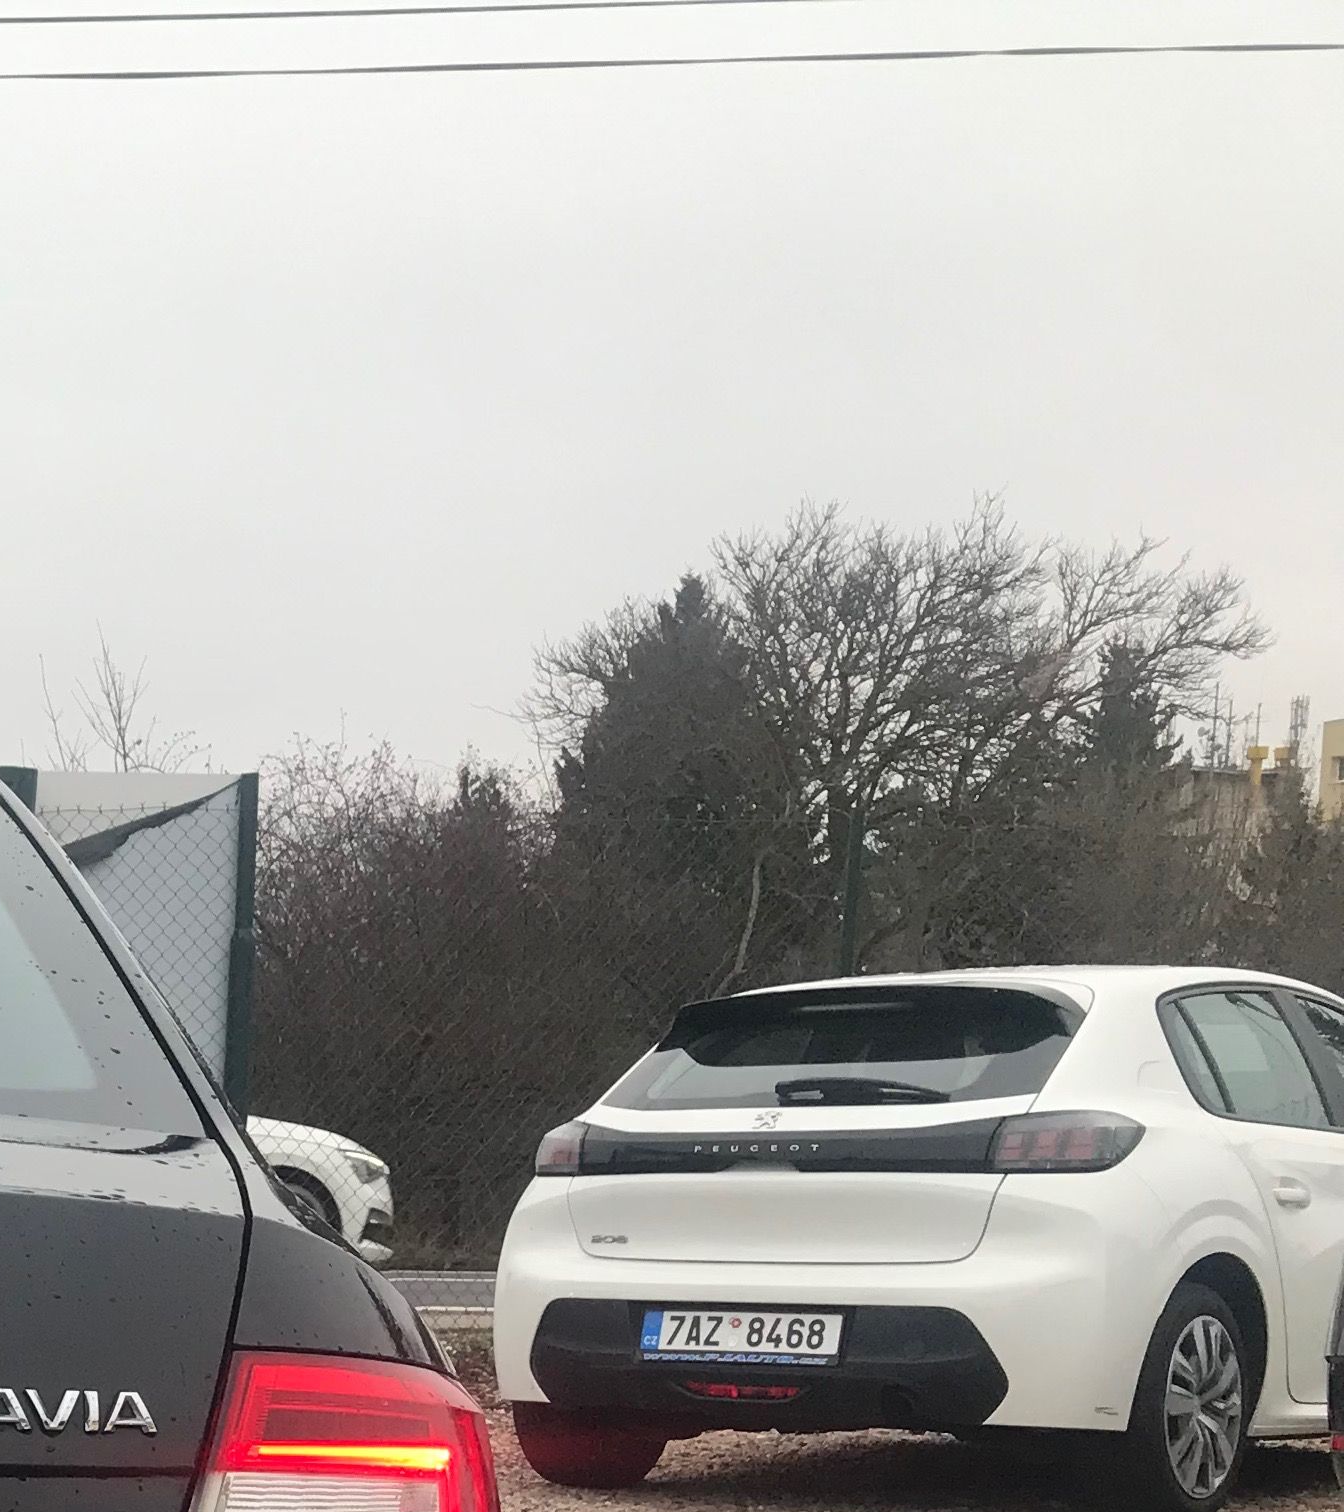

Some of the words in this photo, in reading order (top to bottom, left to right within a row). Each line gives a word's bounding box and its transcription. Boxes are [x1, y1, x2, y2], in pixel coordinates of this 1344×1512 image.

[693, 1144, 820, 1153] PEUGEOT
[666, 1315, 724, 1347] 7AZ
[746, 1316, 826, 1350] 8468
[643, 1335, 658, 1345] CZ
